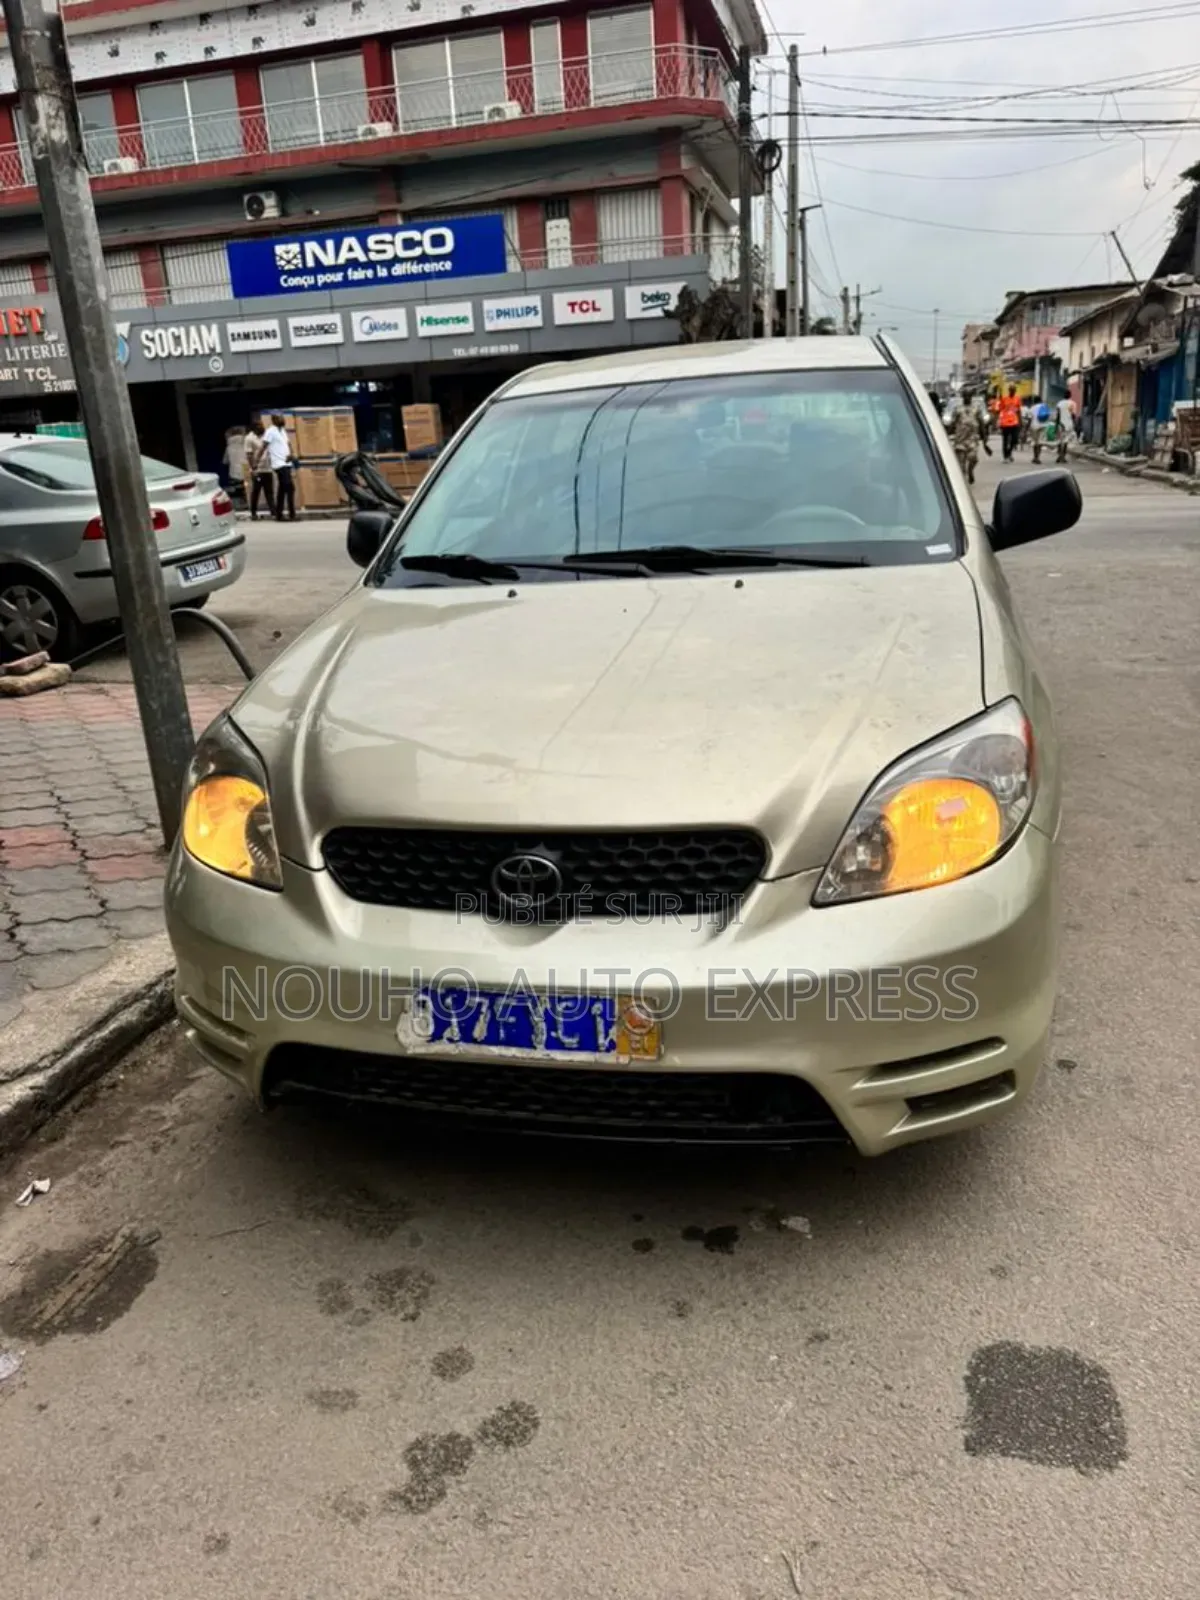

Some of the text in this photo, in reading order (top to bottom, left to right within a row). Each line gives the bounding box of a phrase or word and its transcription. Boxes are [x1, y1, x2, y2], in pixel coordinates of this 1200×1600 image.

[304, 226, 455, 268] NASCO
[280, 259, 452, 289] Conçu pour faire la différence
[641, 291, 671, 303] beko
[496, 305, 539, 319] PHILIPS
[568, 301, 601, 313] TCL
[420, 315, 470, 327] Hisense
[141, 324, 222, 359] SOCIAM
[231, 329, 277, 342] SAMSUNG
[5, 343, 68, 361] LITERIE
[24, 366, 57, 382] TCL
